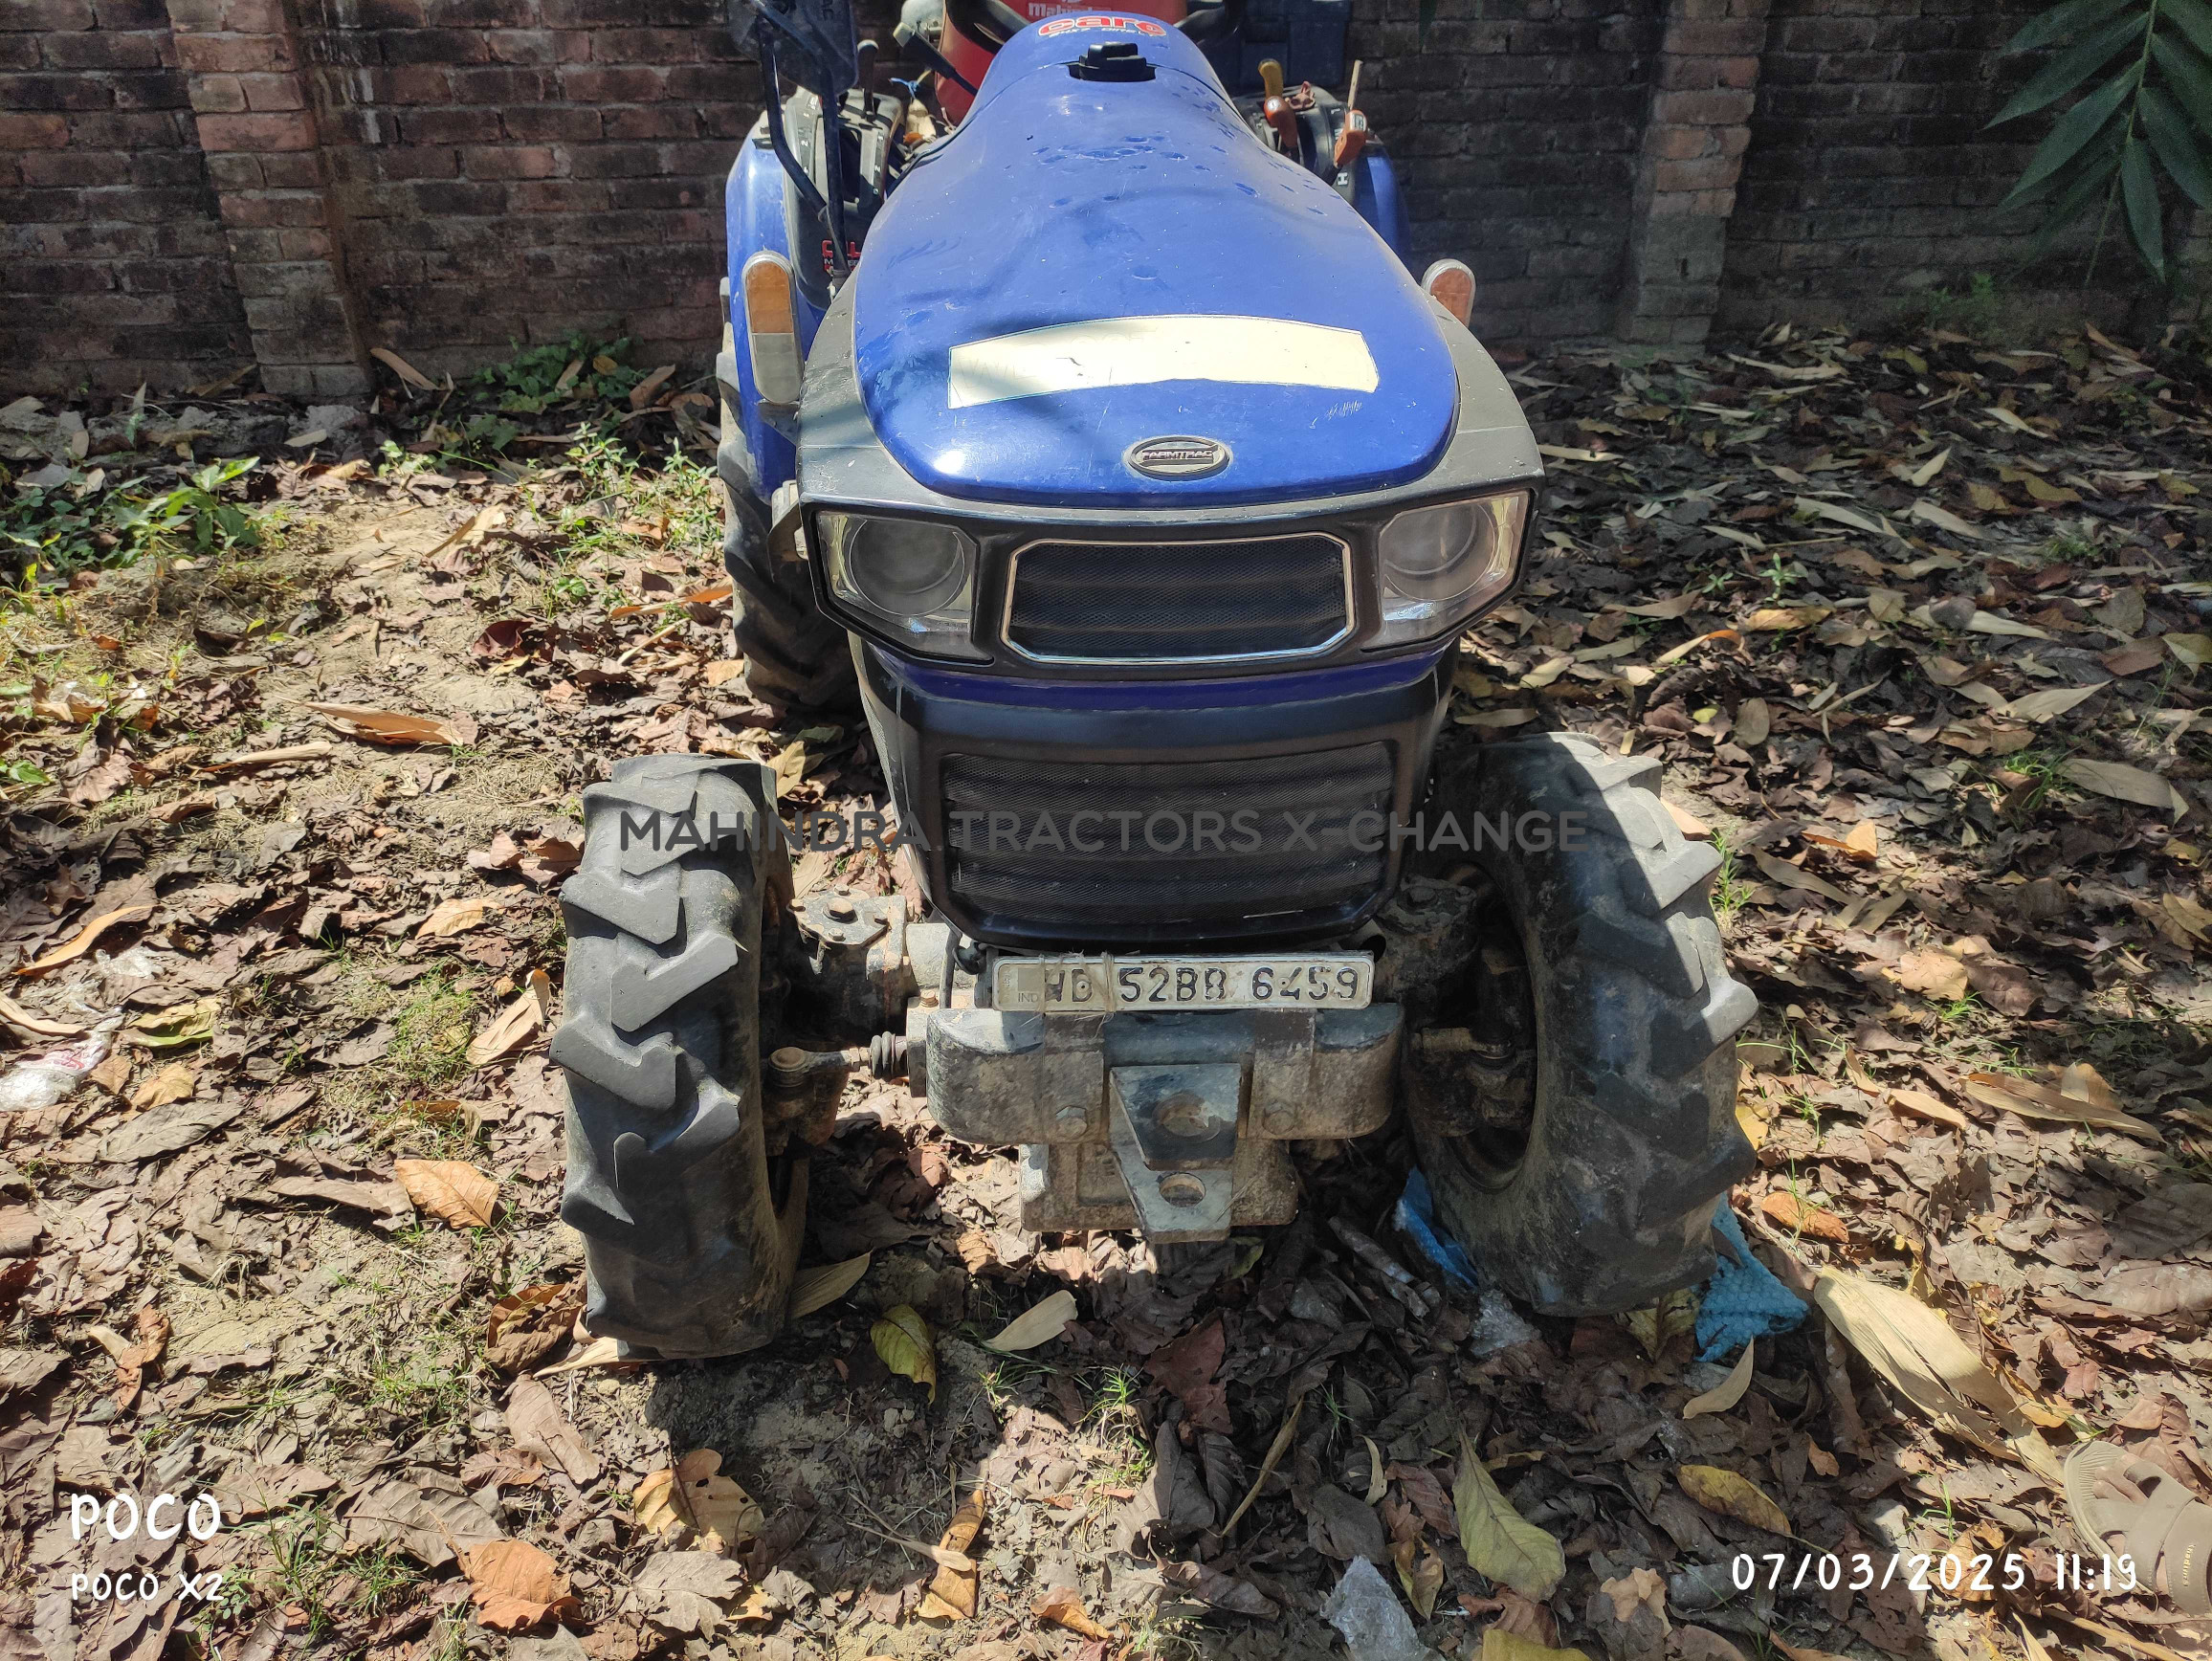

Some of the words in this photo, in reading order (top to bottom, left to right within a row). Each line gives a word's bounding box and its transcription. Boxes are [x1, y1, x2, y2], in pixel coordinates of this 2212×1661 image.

[1141, 450, 1213, 460] FARMTRAC
[1251, 965, 1360, 1002] 6459
[1017, 992, 1039, 1003] IND
